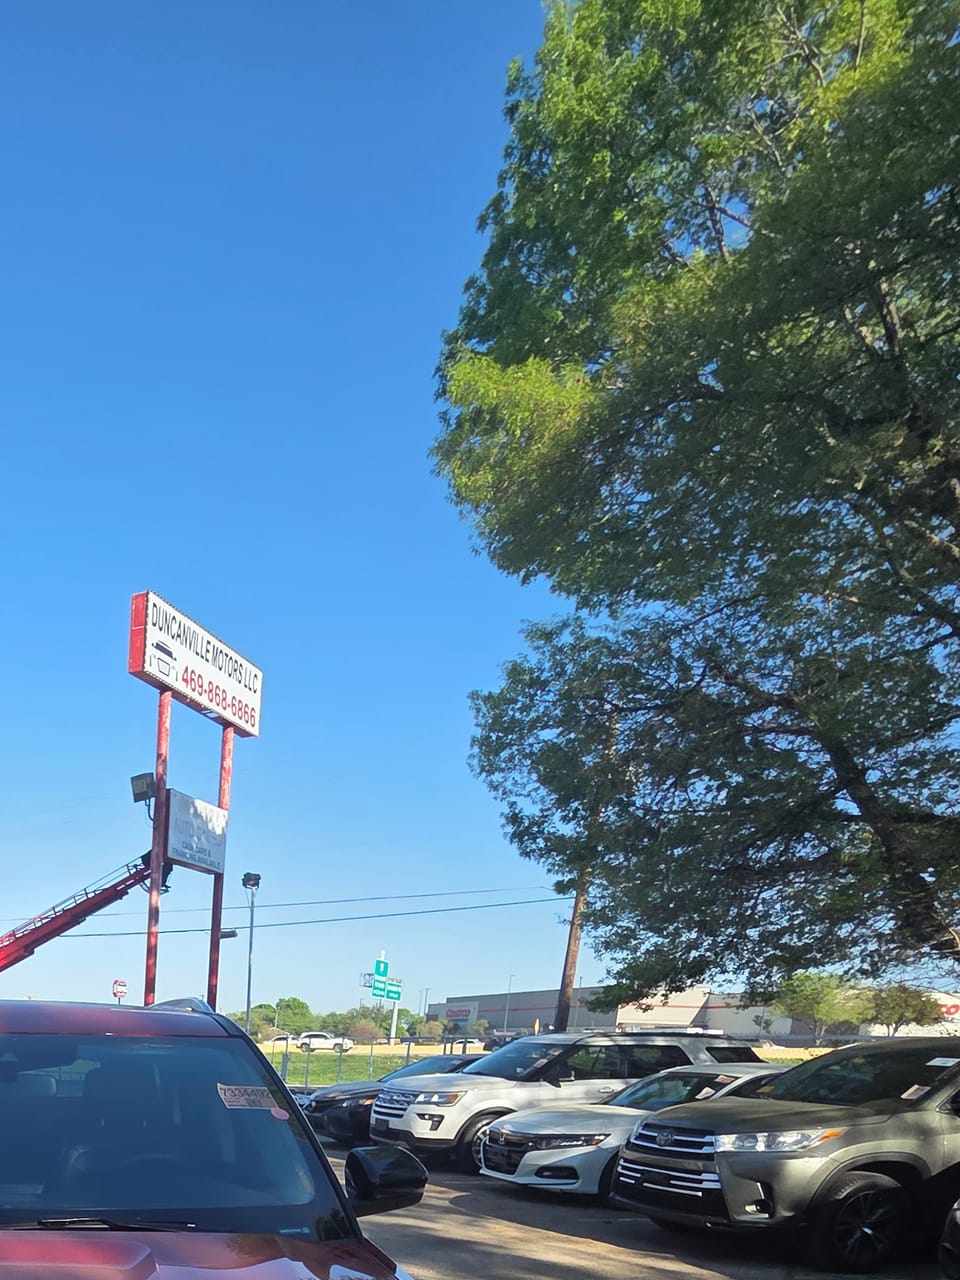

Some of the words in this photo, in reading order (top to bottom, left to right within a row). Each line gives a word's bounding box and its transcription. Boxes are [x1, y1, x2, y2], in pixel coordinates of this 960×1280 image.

[151, 602, 210, 663] DUNCANVILLE
[212, 644, 243, 684] MOTORS
[244, 667, 258, 694] LLC
[182, 665, 256, 728] 469-868-6866
